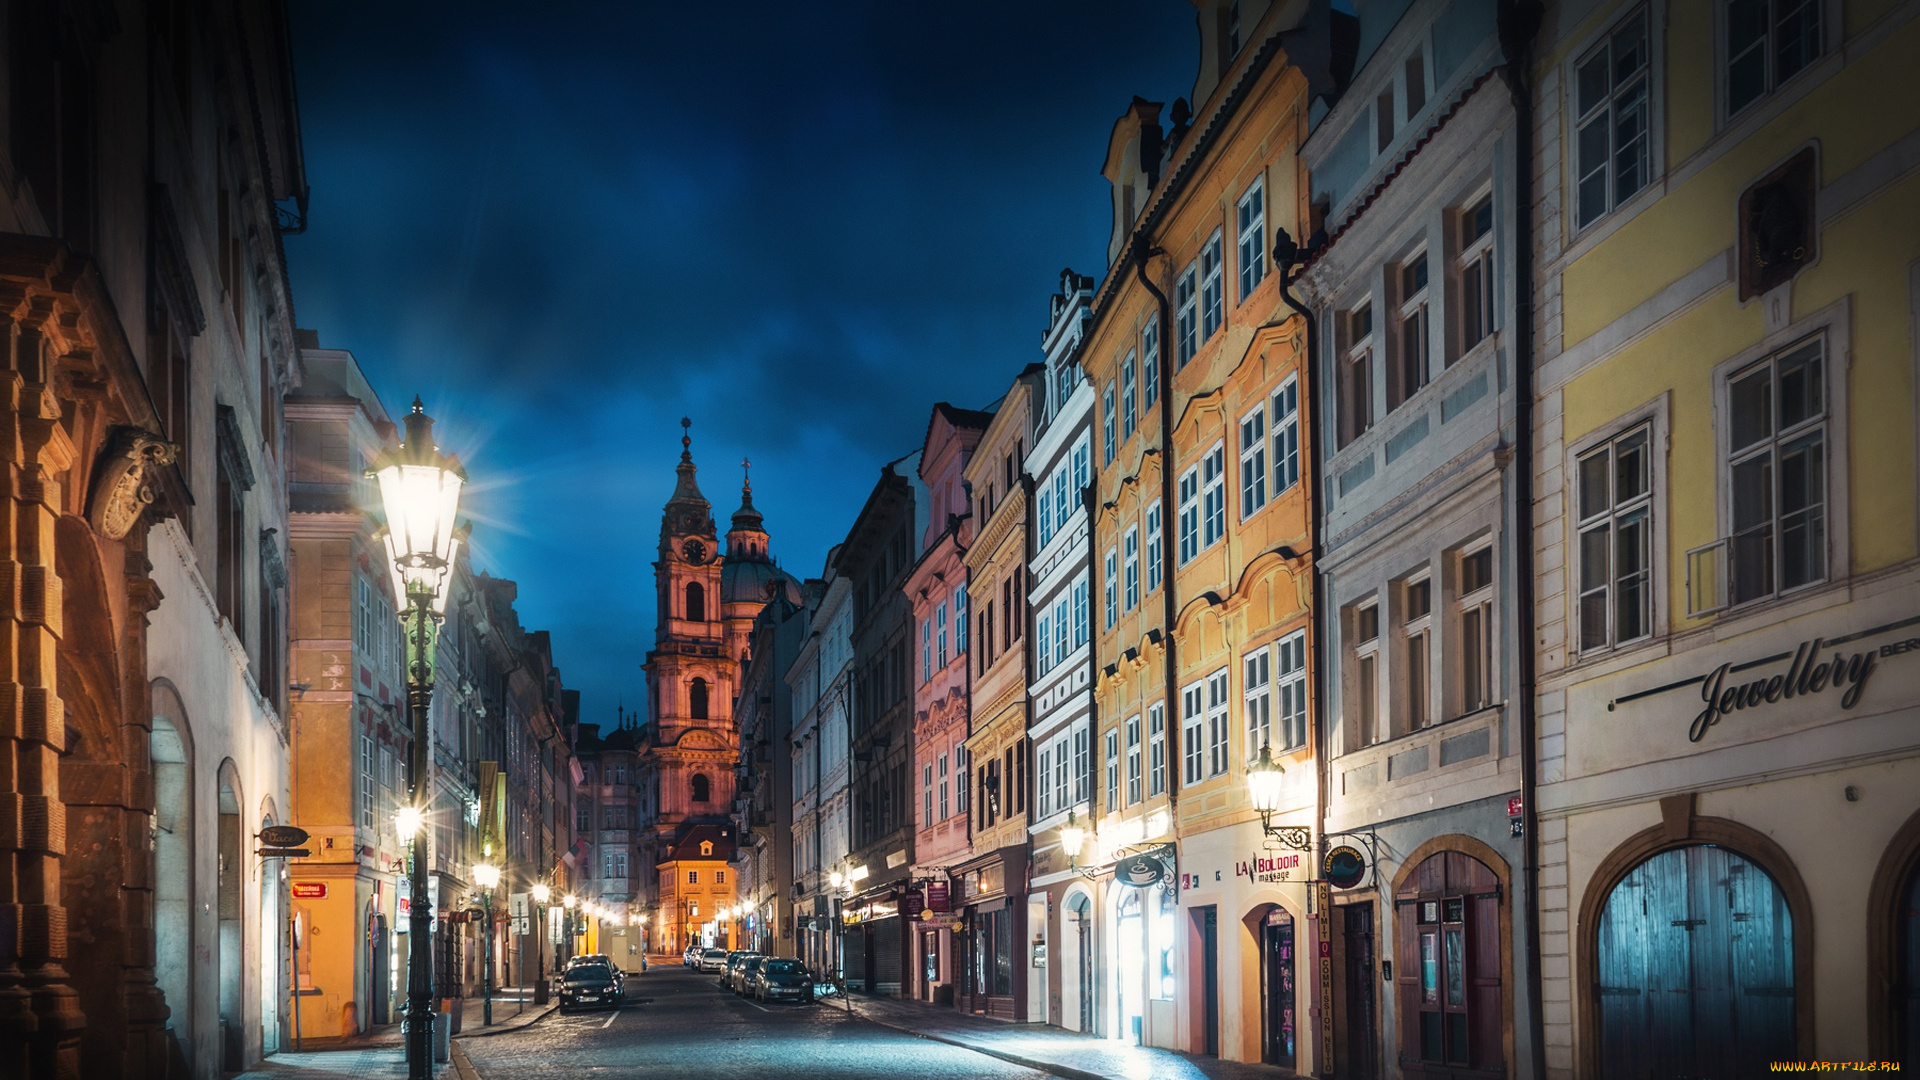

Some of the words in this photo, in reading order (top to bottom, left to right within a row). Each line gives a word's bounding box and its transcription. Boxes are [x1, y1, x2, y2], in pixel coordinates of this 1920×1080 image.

[1880, 637, 1920, 658] BER
[1689, 637, 1880, 742] Jewellery
[1235, 861, 1249, 877] LA
[1258, 870, 1290, 882] massage
[1320, 885, 1328, 900] NO
[1322, 959, 1331, 1032] COMMISSION
[1324, 1036, 1332, 1072] NETTO
